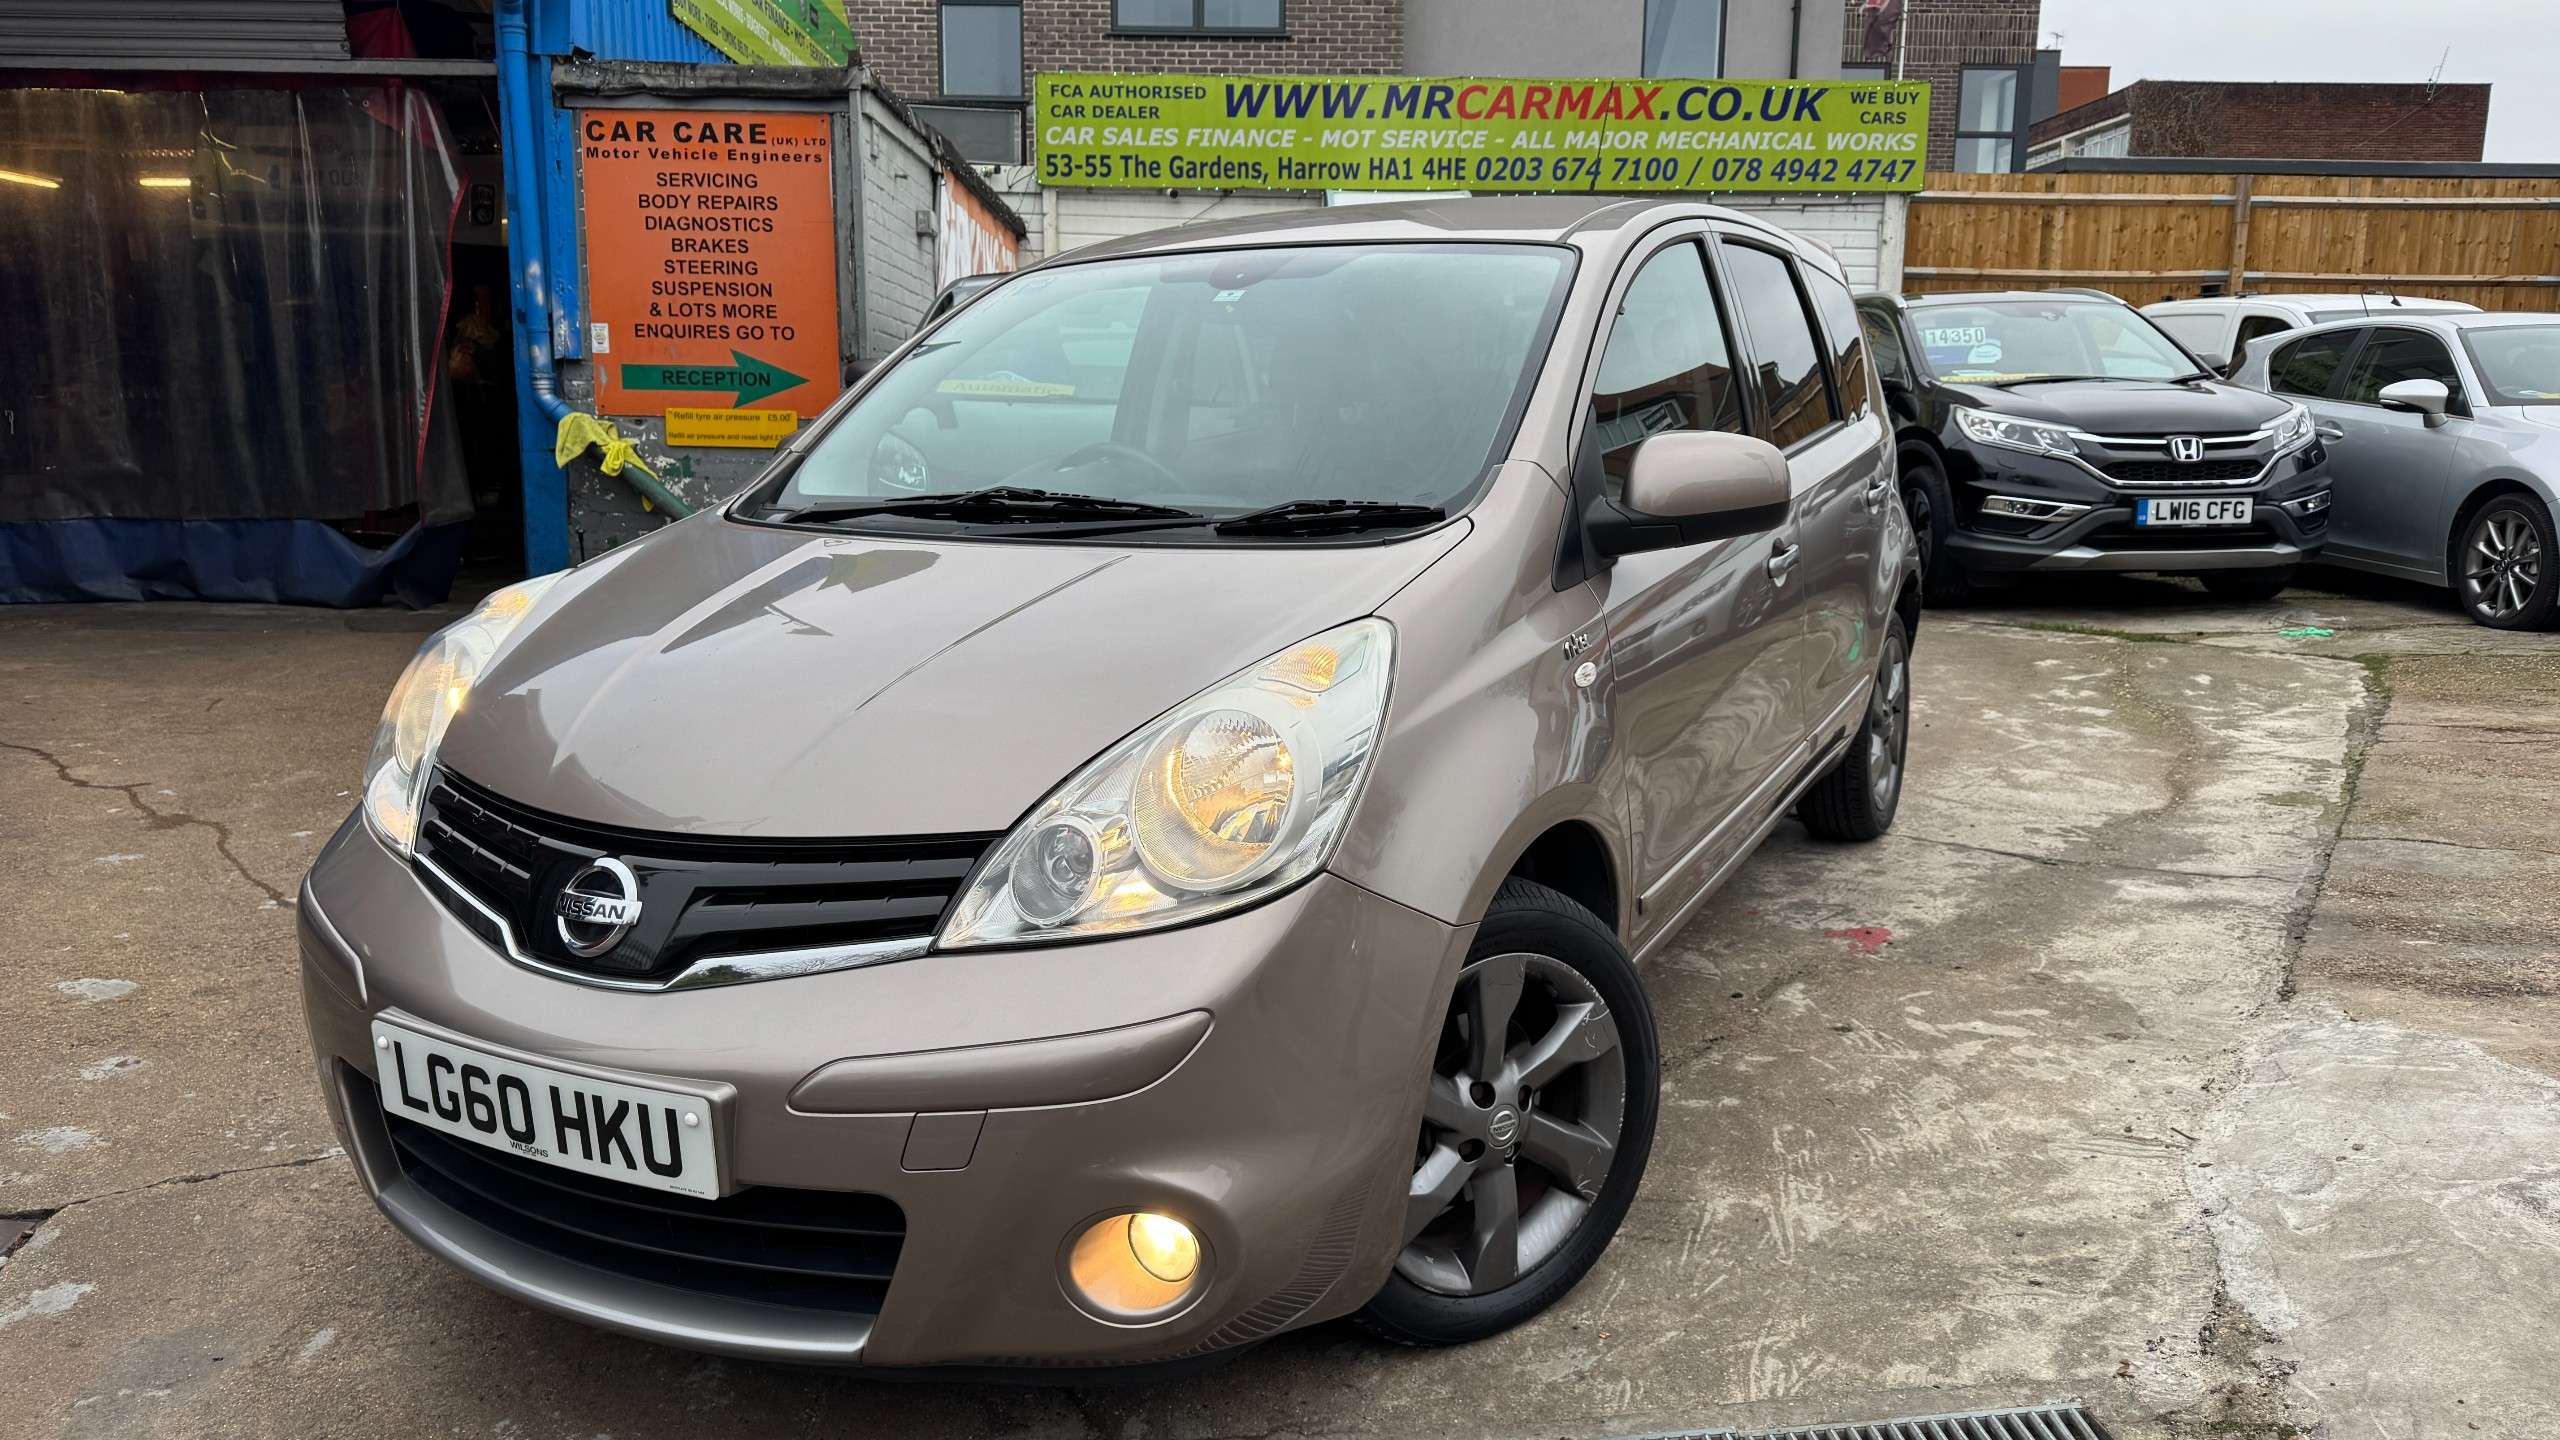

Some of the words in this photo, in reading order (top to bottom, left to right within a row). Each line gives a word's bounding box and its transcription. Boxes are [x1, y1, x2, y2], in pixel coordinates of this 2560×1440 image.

[1051, 85, 1084, 99] FCA
[1089, 85, 1207, 100] AUTHORISED
[1851, 91, 1878, 104] WE
[1885, 91, 1920, 105] BUY
[1225, 84, 1830, 121] WWW.MRCARMAX.CO.UK
[1051, 105, 1086, 119] CAR
[1093, 105, 1160, 119] DEALER
[1860, 111, 1906, 125] CARS
[586, 120, 656, 142] CAR
[673, 122, 767, 145] CARE
[771, 137, 799, 147] (UK)
[804, 137, 826, 146] LTD
[1045, 127, 1094, 145] CAR
[1102, 127, 1178, 147] SALES
[1187, 128, 1296, 148] FINANCE
[1321, 129, 1375, 148] MOT
[1381, 130, 1488, 149] SERVICE
[1512, 130, 1559, 150] ALL
[1564, 131, 1648, 150] MAJOR
[1657, 132, 1815, 151] MECHANICAL
[1826, 133, 1917, 152] WORKS
[586, 147, 640, 159] Motor
[648, 148, 718, 160] Vehicle
[728, 149, 823, 164] Engineers
[1046, 154, 1112, 178] 53-55
[1120, 155, 1160, 178] The
[1169, 155, 1269, 184] Gardens,
[1278, 157, 1360, 181] Harrow
[1369, 158, 1412, 181] HA1
[1422, 158, 1466, 181] 4HE
[1476, 157, 1542, 182] 0203
[1553, 157, 1603, 182] 674
[1612, 157, 1679, 182] 7100
[1712, 158, 1763, 182] 078
[1771, 158, 1838, 183] 4942
[1846, 159, 1917, 184] 4747
[656, 172, 758, 189] SERVICING
[638, 194, 693, 210] BODY
[698, 195, 779, 211] REPAIRS
[645, 216, 774, 233] DIAGNOSTICS
[671, 238, 750, 254] BRAKES
[664, 260, 759, 276] STEERING
[651, 281, 773, 298] SUSPENSION
[649, 303, 663, 318] &
[668, 303, 717, 319] LOTS
[722, 304, 778, 319] MORE
[634, 324, 730, 341] ENQUIRES
[736, 325, 765, 341] GO
[770, 325, 796, 341] TO
[1929, 328, 1985, 344] 14350
[662, 370, 771, 387] RECEPTION
[696, 412, 711, 421] tyre
[726, 414, 760, 422] pressure
[2155, 501, 2200, 521] LW16
[2206, 501, 2246, 519] CFG
[557, 895, 627, 922] NISSAN
[393, 1041, 537, 1146] LG60
[549, 1085, 683, 1178] HKU
[509, 1140, 549, 1158] WILSONS
